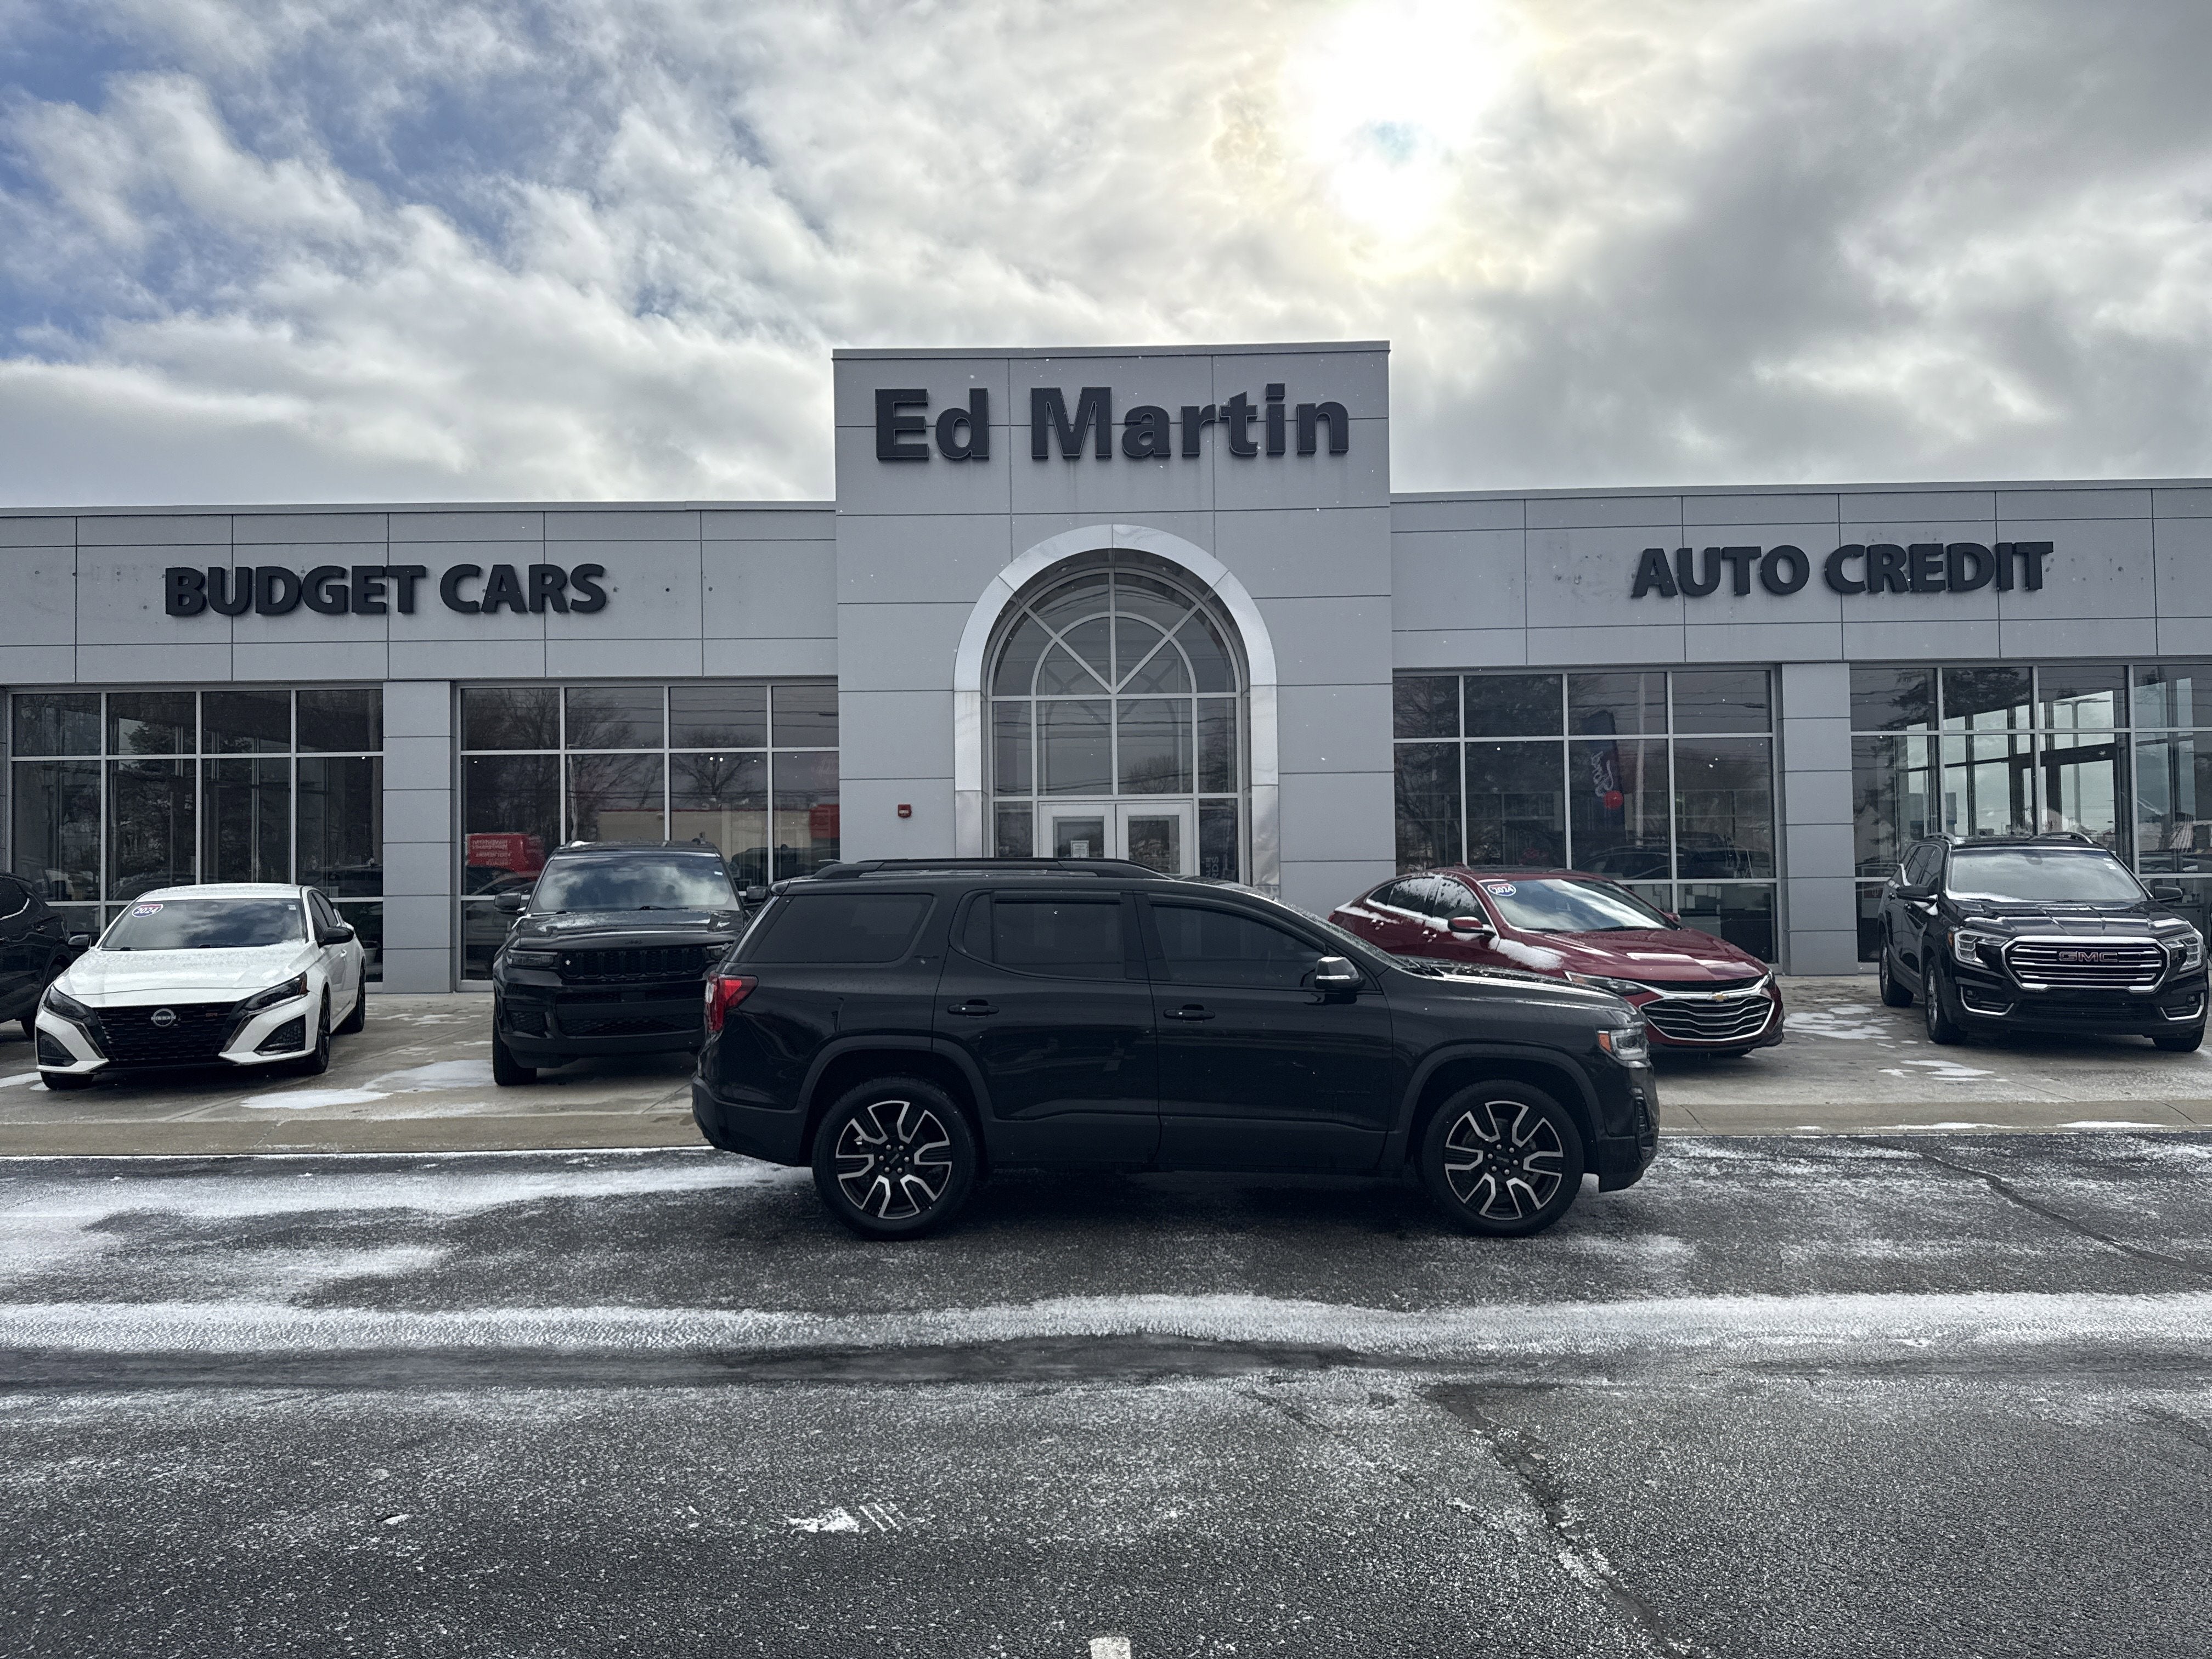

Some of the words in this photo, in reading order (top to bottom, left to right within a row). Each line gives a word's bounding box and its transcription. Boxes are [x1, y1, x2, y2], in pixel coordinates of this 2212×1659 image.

[875, 388, 989, 461] Ed
[1030, 383, 1350, 459] Martin
[165, 565, 426, 616] BUDGET
[439, 563, 607, 614] CARS
[1631, 544, 1810, 597] AUTO
[1824, 541, 2054, 594] CREDIT
[2059, 951, 2118, 962] GMC
